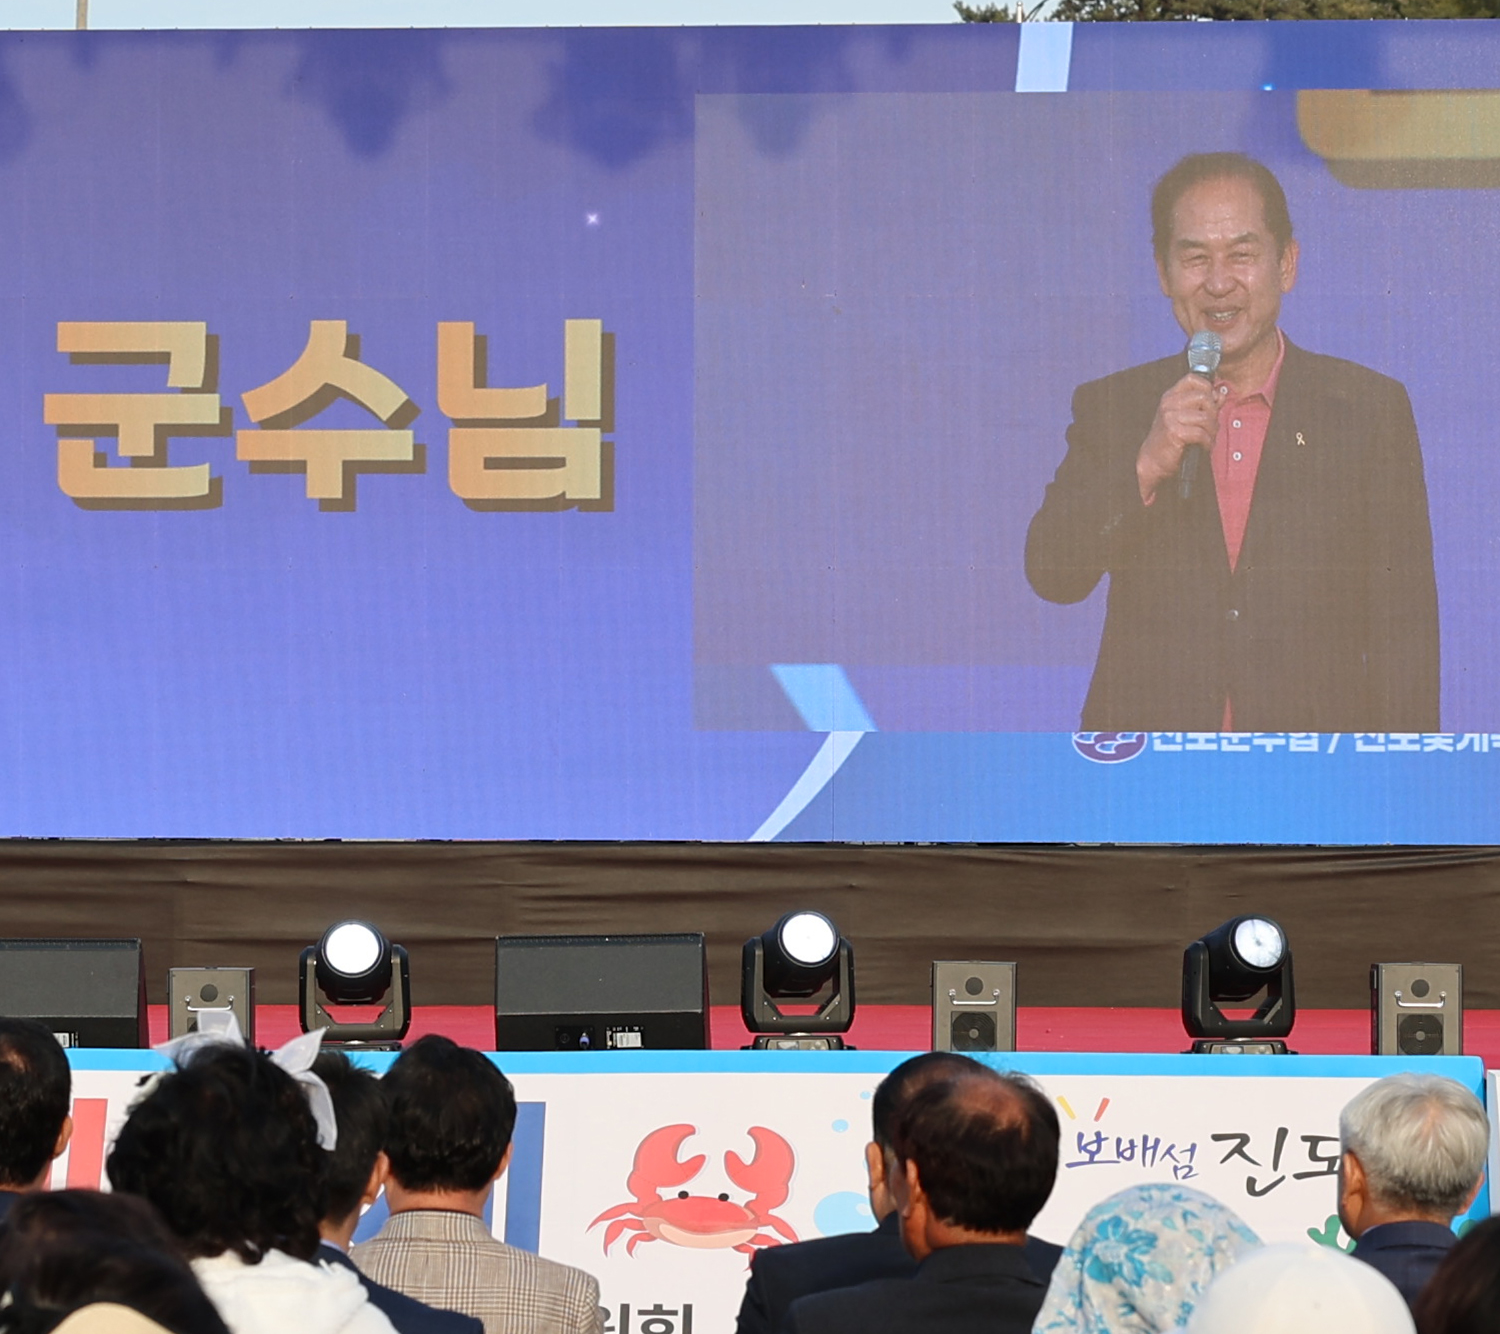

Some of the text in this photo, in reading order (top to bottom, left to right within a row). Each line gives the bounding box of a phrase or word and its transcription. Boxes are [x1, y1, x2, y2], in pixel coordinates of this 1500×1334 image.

[43, 317, 615, 513] 군수님
[1065, 1126, 1341, 1198] 보배섬 진도
